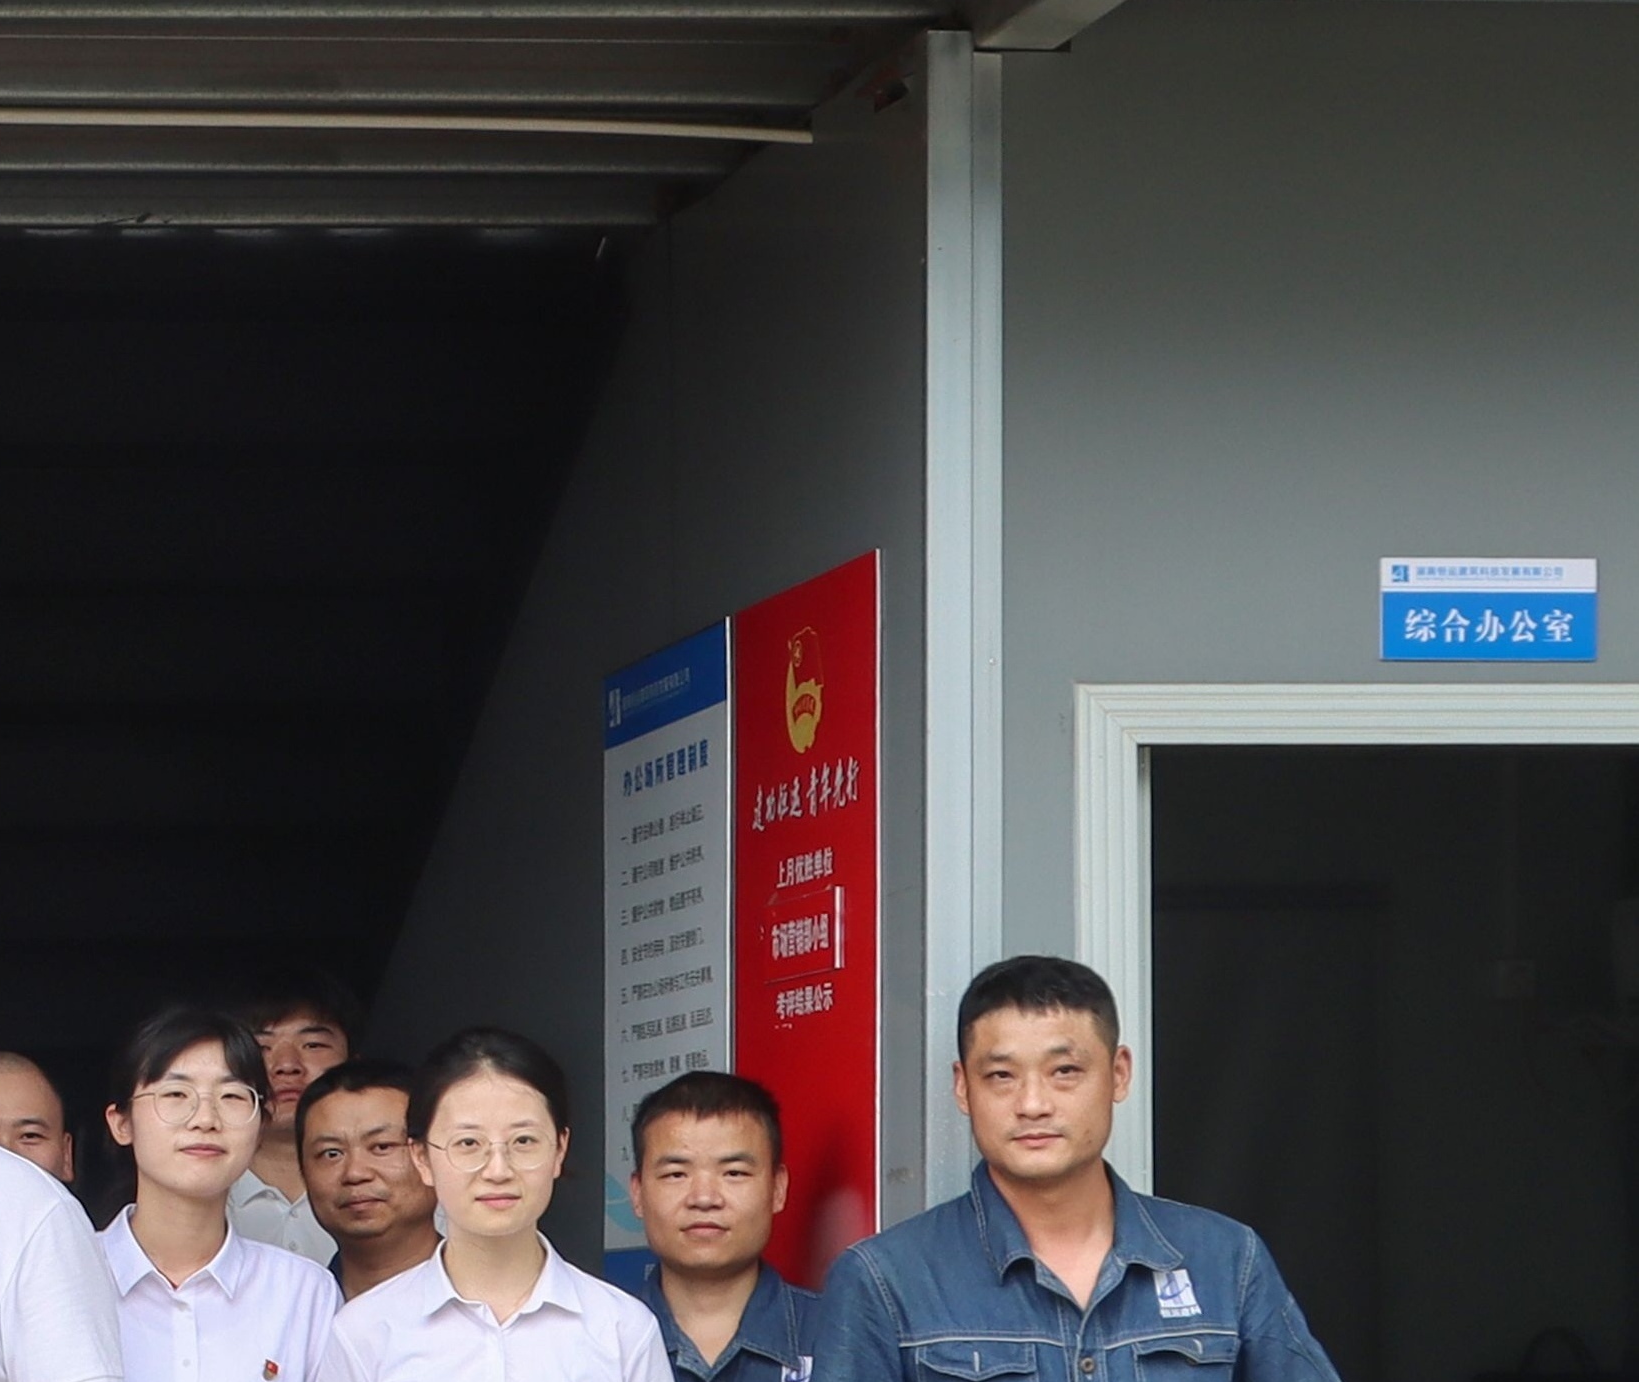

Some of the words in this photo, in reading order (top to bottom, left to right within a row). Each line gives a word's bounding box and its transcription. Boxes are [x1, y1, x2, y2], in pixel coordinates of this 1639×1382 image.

[1404, 608, 1574, 643] 综合办公室
[776, 847, 834, 888] 上月优胜单位
[776, 982, 834, 1020] 考评结果公示
